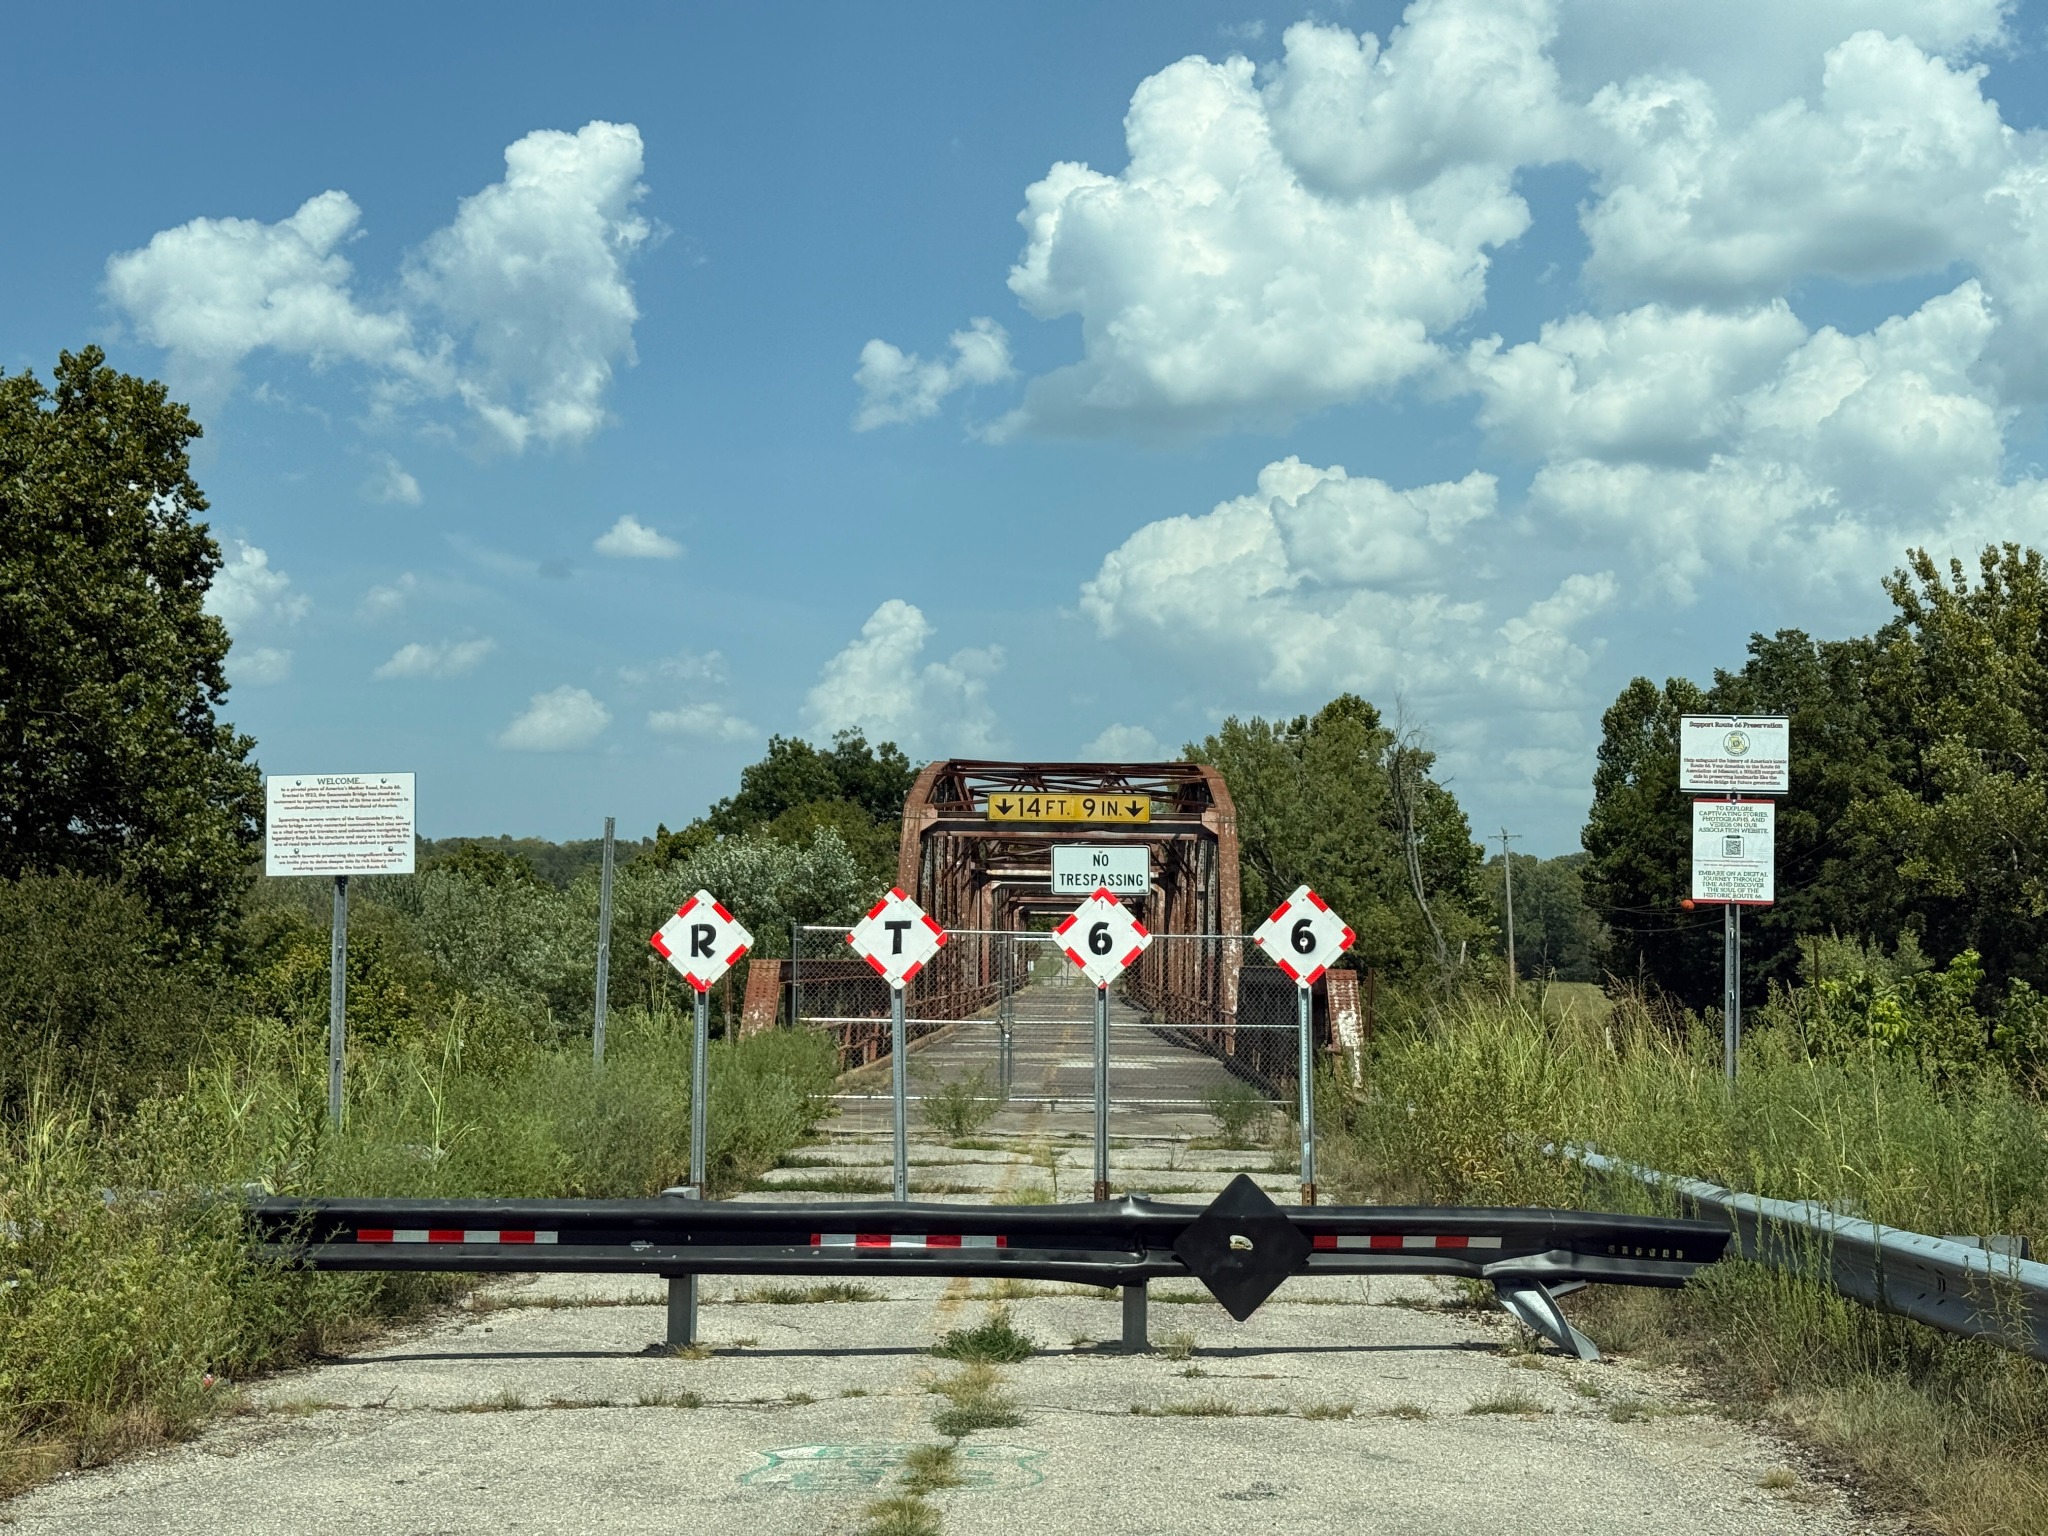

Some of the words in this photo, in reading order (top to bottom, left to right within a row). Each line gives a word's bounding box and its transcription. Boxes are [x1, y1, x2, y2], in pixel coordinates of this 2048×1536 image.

[1018, 797, 1041, 818] 14
[1045, 800, 1070, 816] FT.
[1082, 798, 1096, 818] 9
[1101, 801, 1123, 817] IN.
[1092, 854, 1109, 867] NO
[1060, 873, 1144, 887] TRESPASSING
[690, 923, 717, 959] R
[884, 920, 912, 955] T
[1088, 921, 1113, 956] 6
[1290, 918, 1317, 955] 6
